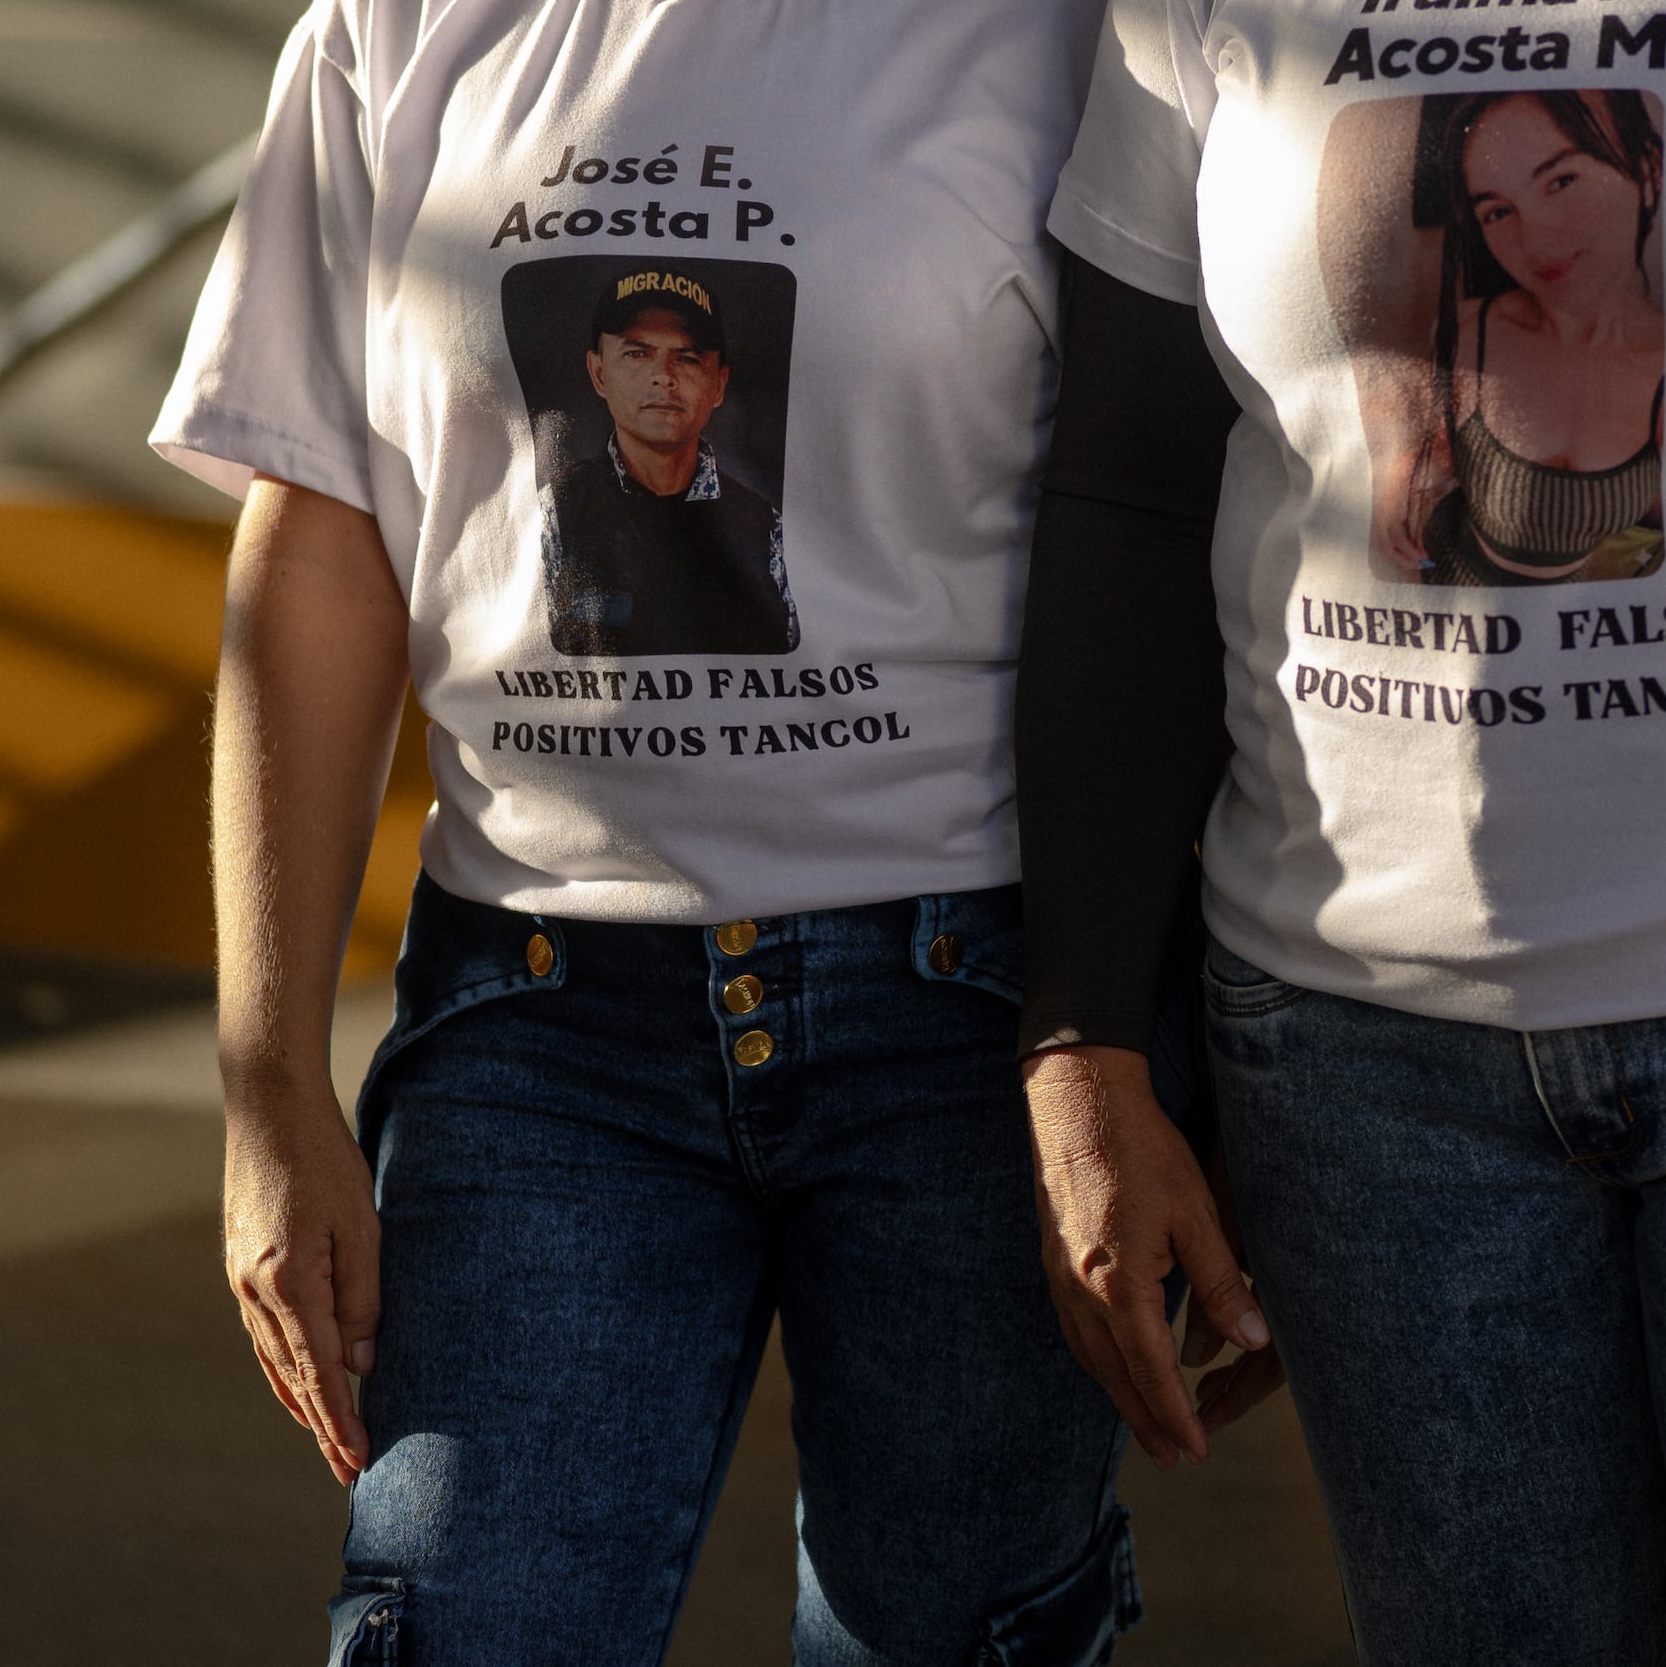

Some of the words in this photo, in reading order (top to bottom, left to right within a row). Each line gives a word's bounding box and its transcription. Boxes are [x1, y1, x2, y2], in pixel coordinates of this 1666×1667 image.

[1323, 26, 1569, 85] Acosta
[541, 143, 679, 188] José
[700, 145, 753, 190] E.
[490, 200, 710, 249] Acosta
[735, 200, 796, 247] P.
[1301, 596, 1522, 655] LIBERTAD
[495, 669, 693, 701] LIBERTAD
[706, 663, 880, 699] FALSOS
[1295, 663, 1546, 727] POSITIVOS
[492, 721, 707, 757] POSITIVOS
[720, 711, 911, 756] TANCOL
